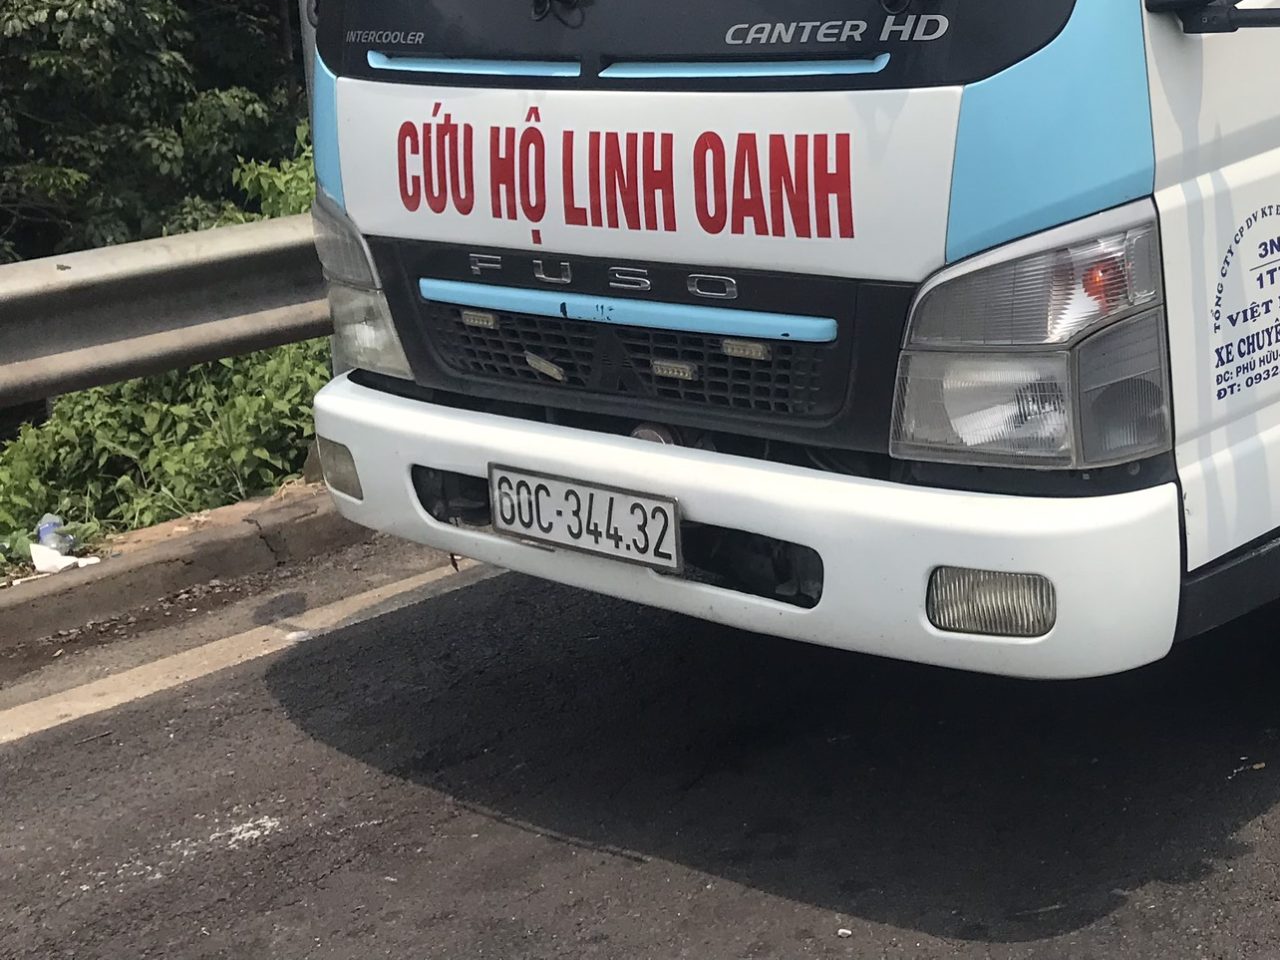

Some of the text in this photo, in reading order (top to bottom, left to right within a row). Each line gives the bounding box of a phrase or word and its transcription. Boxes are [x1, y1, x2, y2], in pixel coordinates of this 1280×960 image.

[346, 30, 425, 44] INTERCOOLER
[725, 14, 949, 45] CANTER HD
[397, 102, 855, 244] CỨU HỘ LINH OANH
[1220, 244, 1235, 278] CTY
[1233, 225, 1245, 245] CP
[1245, 211, 1259, 230] DV
[1261, 204, 1274, 219] KT
[469, 253, 738, 299] FUSO
[1227, 301, 1273, 327] VIỆT
[1214, 343, 1234, 368] XE
[1216, 370, 1233, 385] ĐC:
[1235, 356, 1256, 377] PHÚ
[1216, 383, 1241, 400] ĐT:
[497, 475, 672, 561] 60C-344.32
